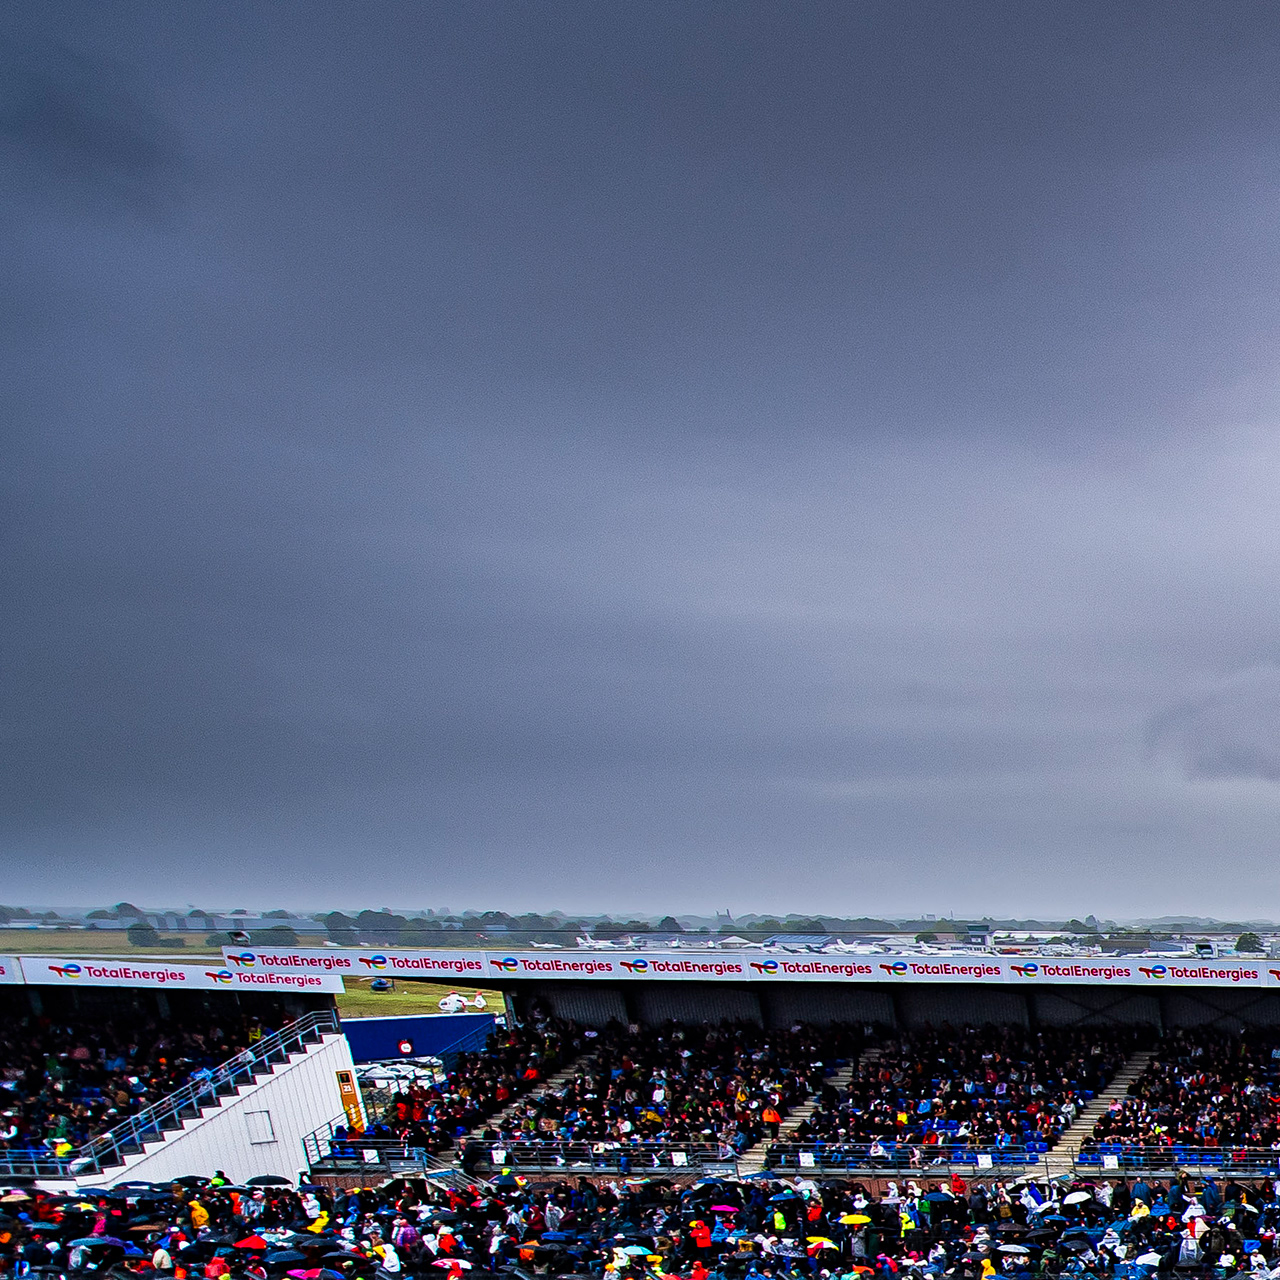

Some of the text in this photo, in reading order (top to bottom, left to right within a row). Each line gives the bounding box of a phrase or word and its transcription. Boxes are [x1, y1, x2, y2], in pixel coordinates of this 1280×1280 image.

[258, 955, 350, 969] TotalEnergies
[389, 958, 482, 972] TotalEnergies
[520, 960, 612, 974] TotalEnergies
[650, 961, 742, 975] TotalEnergies
[780, 962, 872, 976] TotalEnergies
[84, 966, 185, 982] TotalEnergies
[909, 964, 1000, 977] TotalEnergies
[1041, 965, 1130, 979] TotalEnergies
[1168, 967, 1258, 981] TotalEnergies
[236, 973, 321, 987] TotalEnergies
[343, 1084, 352, 1092] 21
